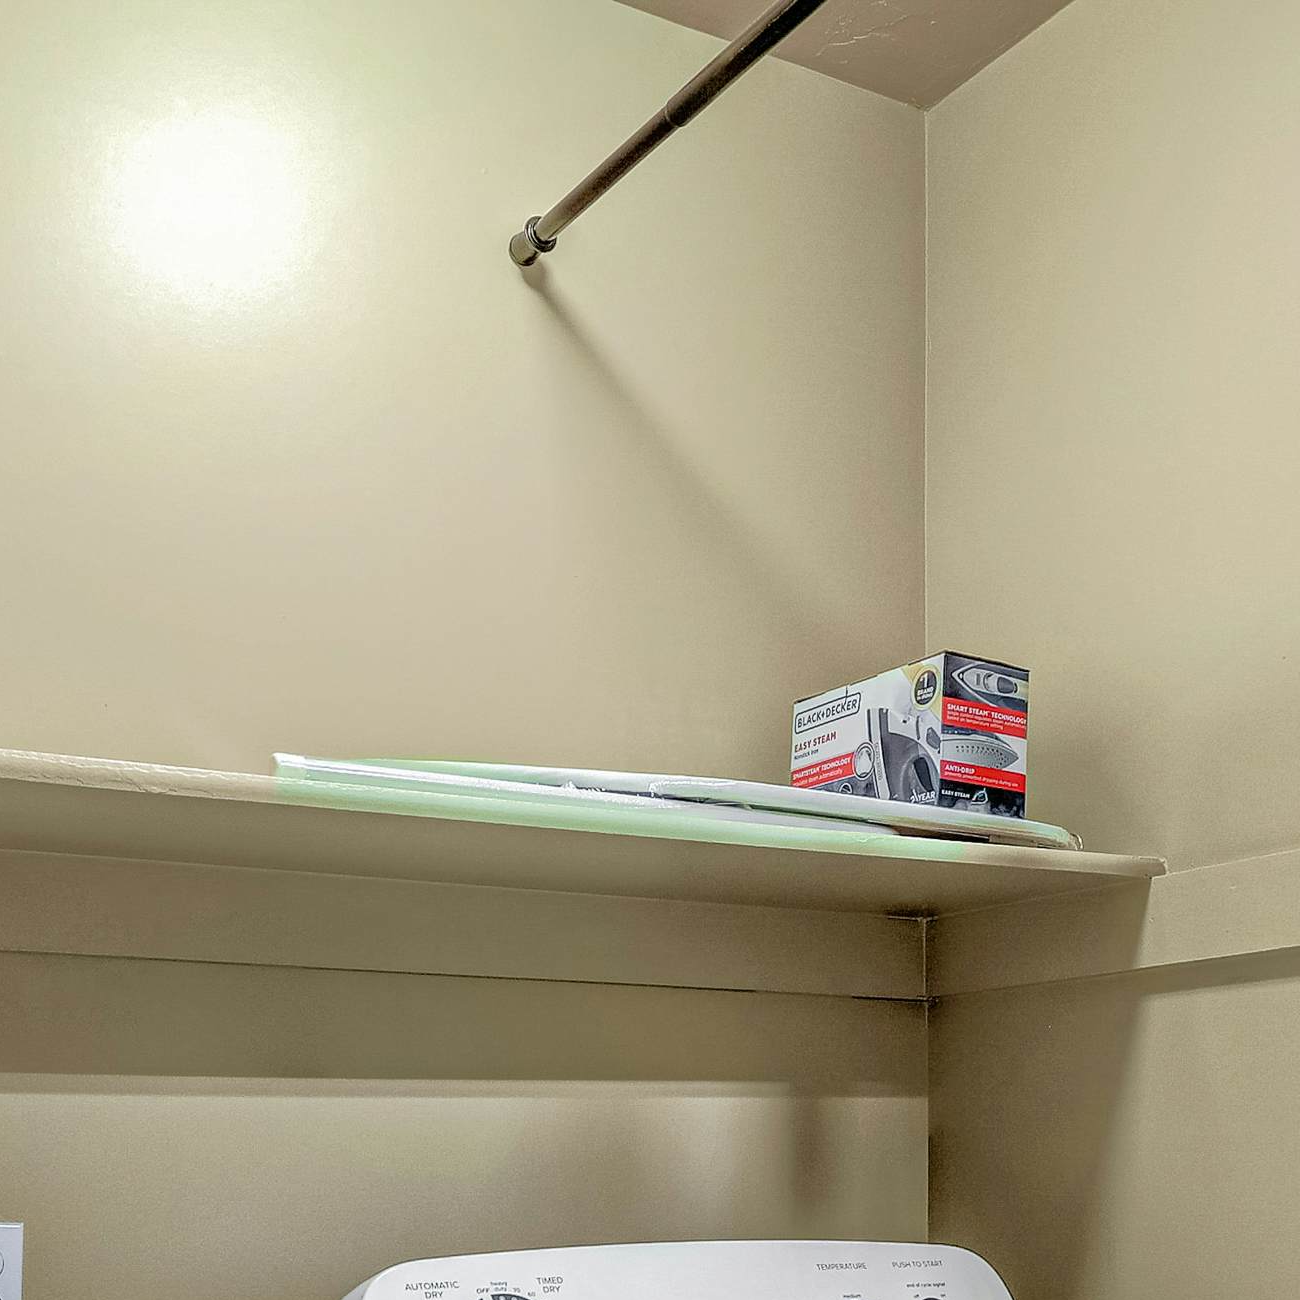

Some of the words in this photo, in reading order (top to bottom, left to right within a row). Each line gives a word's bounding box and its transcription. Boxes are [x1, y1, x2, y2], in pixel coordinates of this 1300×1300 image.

[947, 704, 967, 712] SMART
[797, 699, 857, 728] BLACK+DECKER
[795, 741, 811, 753] EASY
[814, 731, 836, 746] STEAM
[817, 1263, 867, 1271] TEMPERATURE
[405, 1281, 460, 1291] AUTOMATIC
